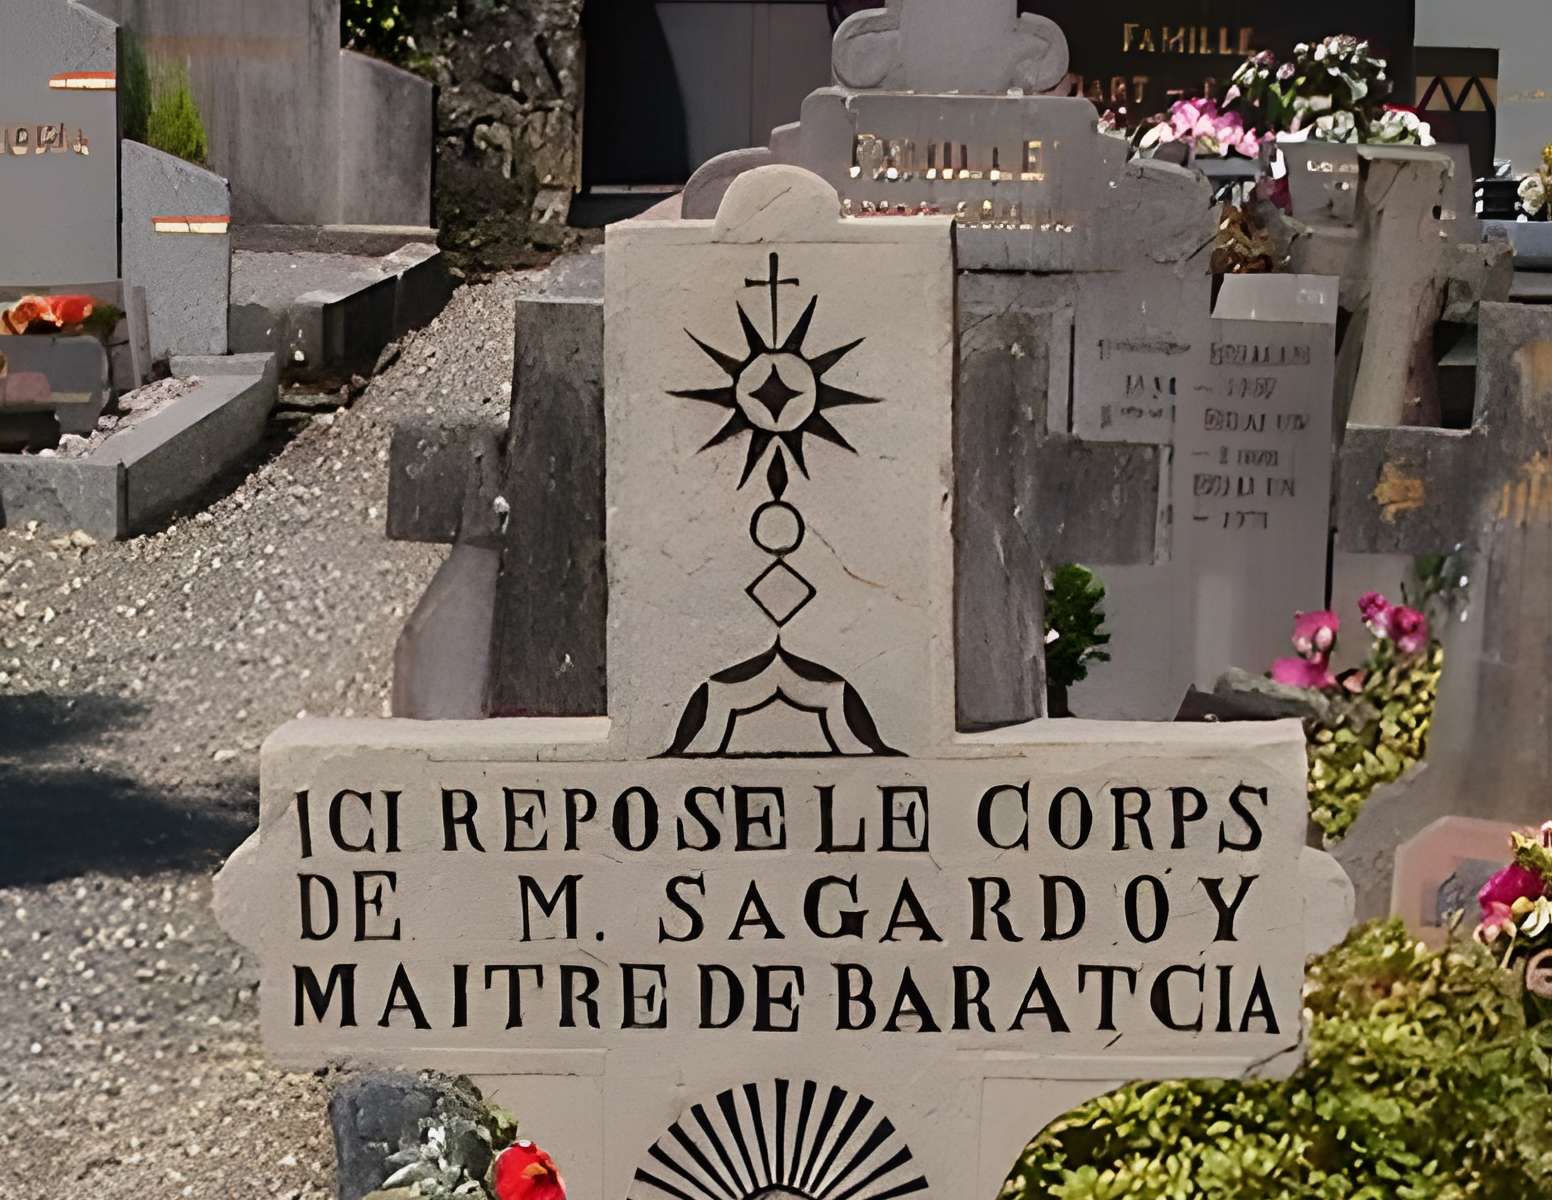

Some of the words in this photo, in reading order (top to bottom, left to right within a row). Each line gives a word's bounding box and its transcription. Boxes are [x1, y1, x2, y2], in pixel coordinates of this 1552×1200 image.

[1122, 23, 1256, 55] FAMILLE
[295, 789, 402, 858] ICI
[441, 785, 786, 852] REPOSE
[813, 785, 929, 854] LE
[978, 781, 1267, 853] CORPS
[297, 871, 400, 942] DE
[518, 874, 605, 943] M.
[659, 871, 1259, 943] SAGARDOY
[293, 962, 667, 1030] MAITRE
[697, 964, 804, 1032] DE
[831, 963, 1280, 1034] BARATCIA
